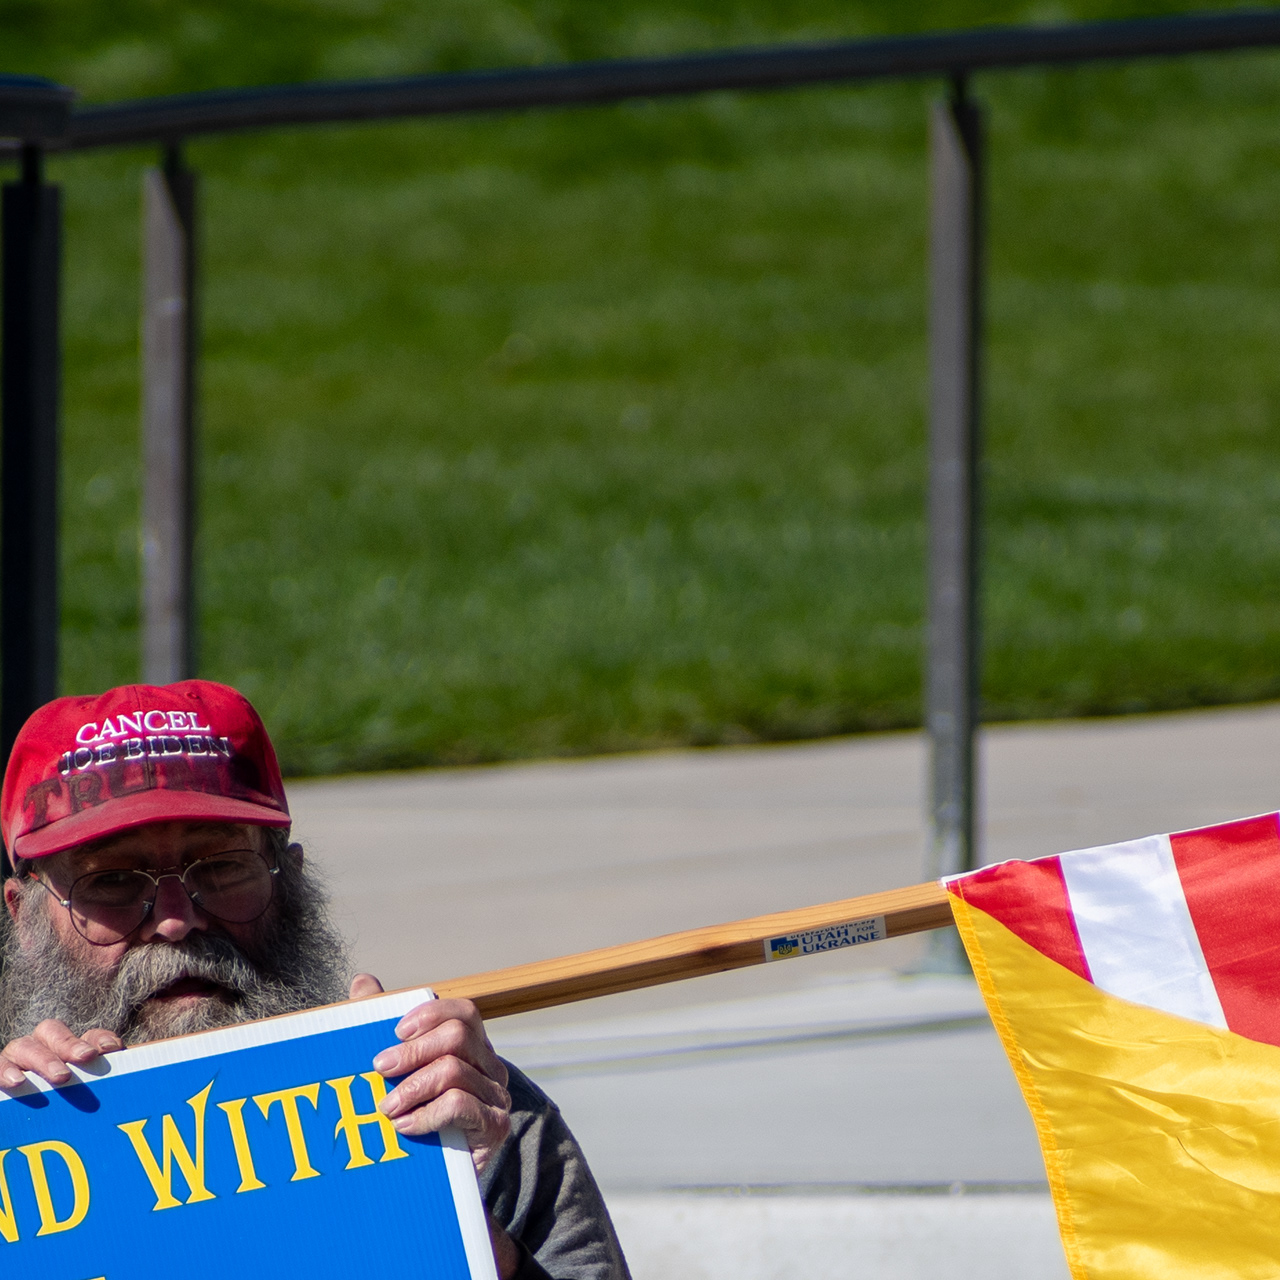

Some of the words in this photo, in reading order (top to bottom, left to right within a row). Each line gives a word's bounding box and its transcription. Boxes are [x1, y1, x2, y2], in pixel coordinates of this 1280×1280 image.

[76, 710, 210, 745] CANCEL
[61, 743, 116, 776] JOE
[123, 734, 232, 760] BIDEN
[802, 929, 849, 945] UTAH
[856, 924, 876, 933] FOR
[803, 930, 880, 954] UKRAINE
[117, 1070, 410, 1212] WITH
